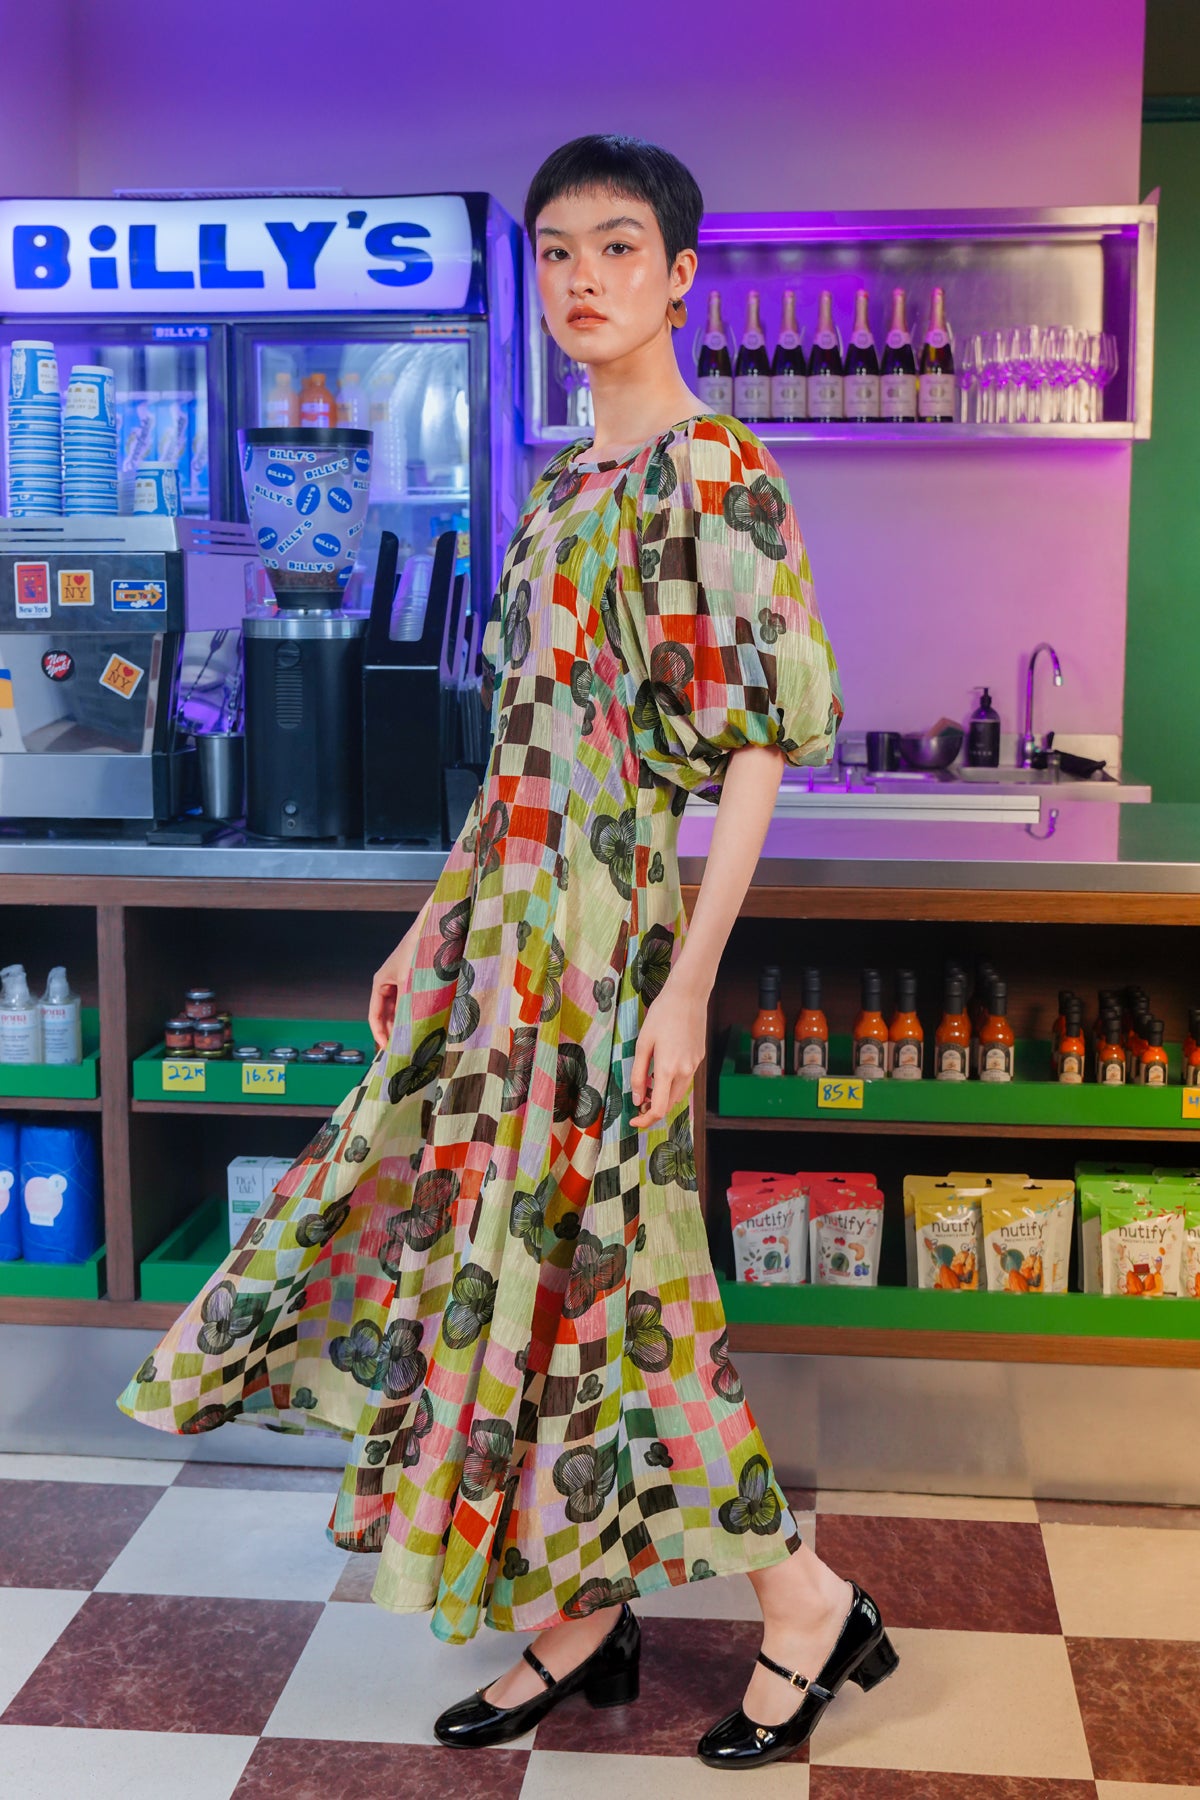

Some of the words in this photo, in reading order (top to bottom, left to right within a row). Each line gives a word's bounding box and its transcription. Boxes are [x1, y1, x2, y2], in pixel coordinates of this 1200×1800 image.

[65, 587, 87, 599] NY
[19, 606, 32, 614] New
[34, 605, 48, 614] York
[107, 672, 132, 689] NY
[746, 1210, 792, 1228] nutify
[823, 1214, 865, 1235] nutify
[932, 1218, 978, 1235] nutify
[1001, 1221, 1044, 1239] nutify
[1119, 1225, 1166, 1243] nutify
